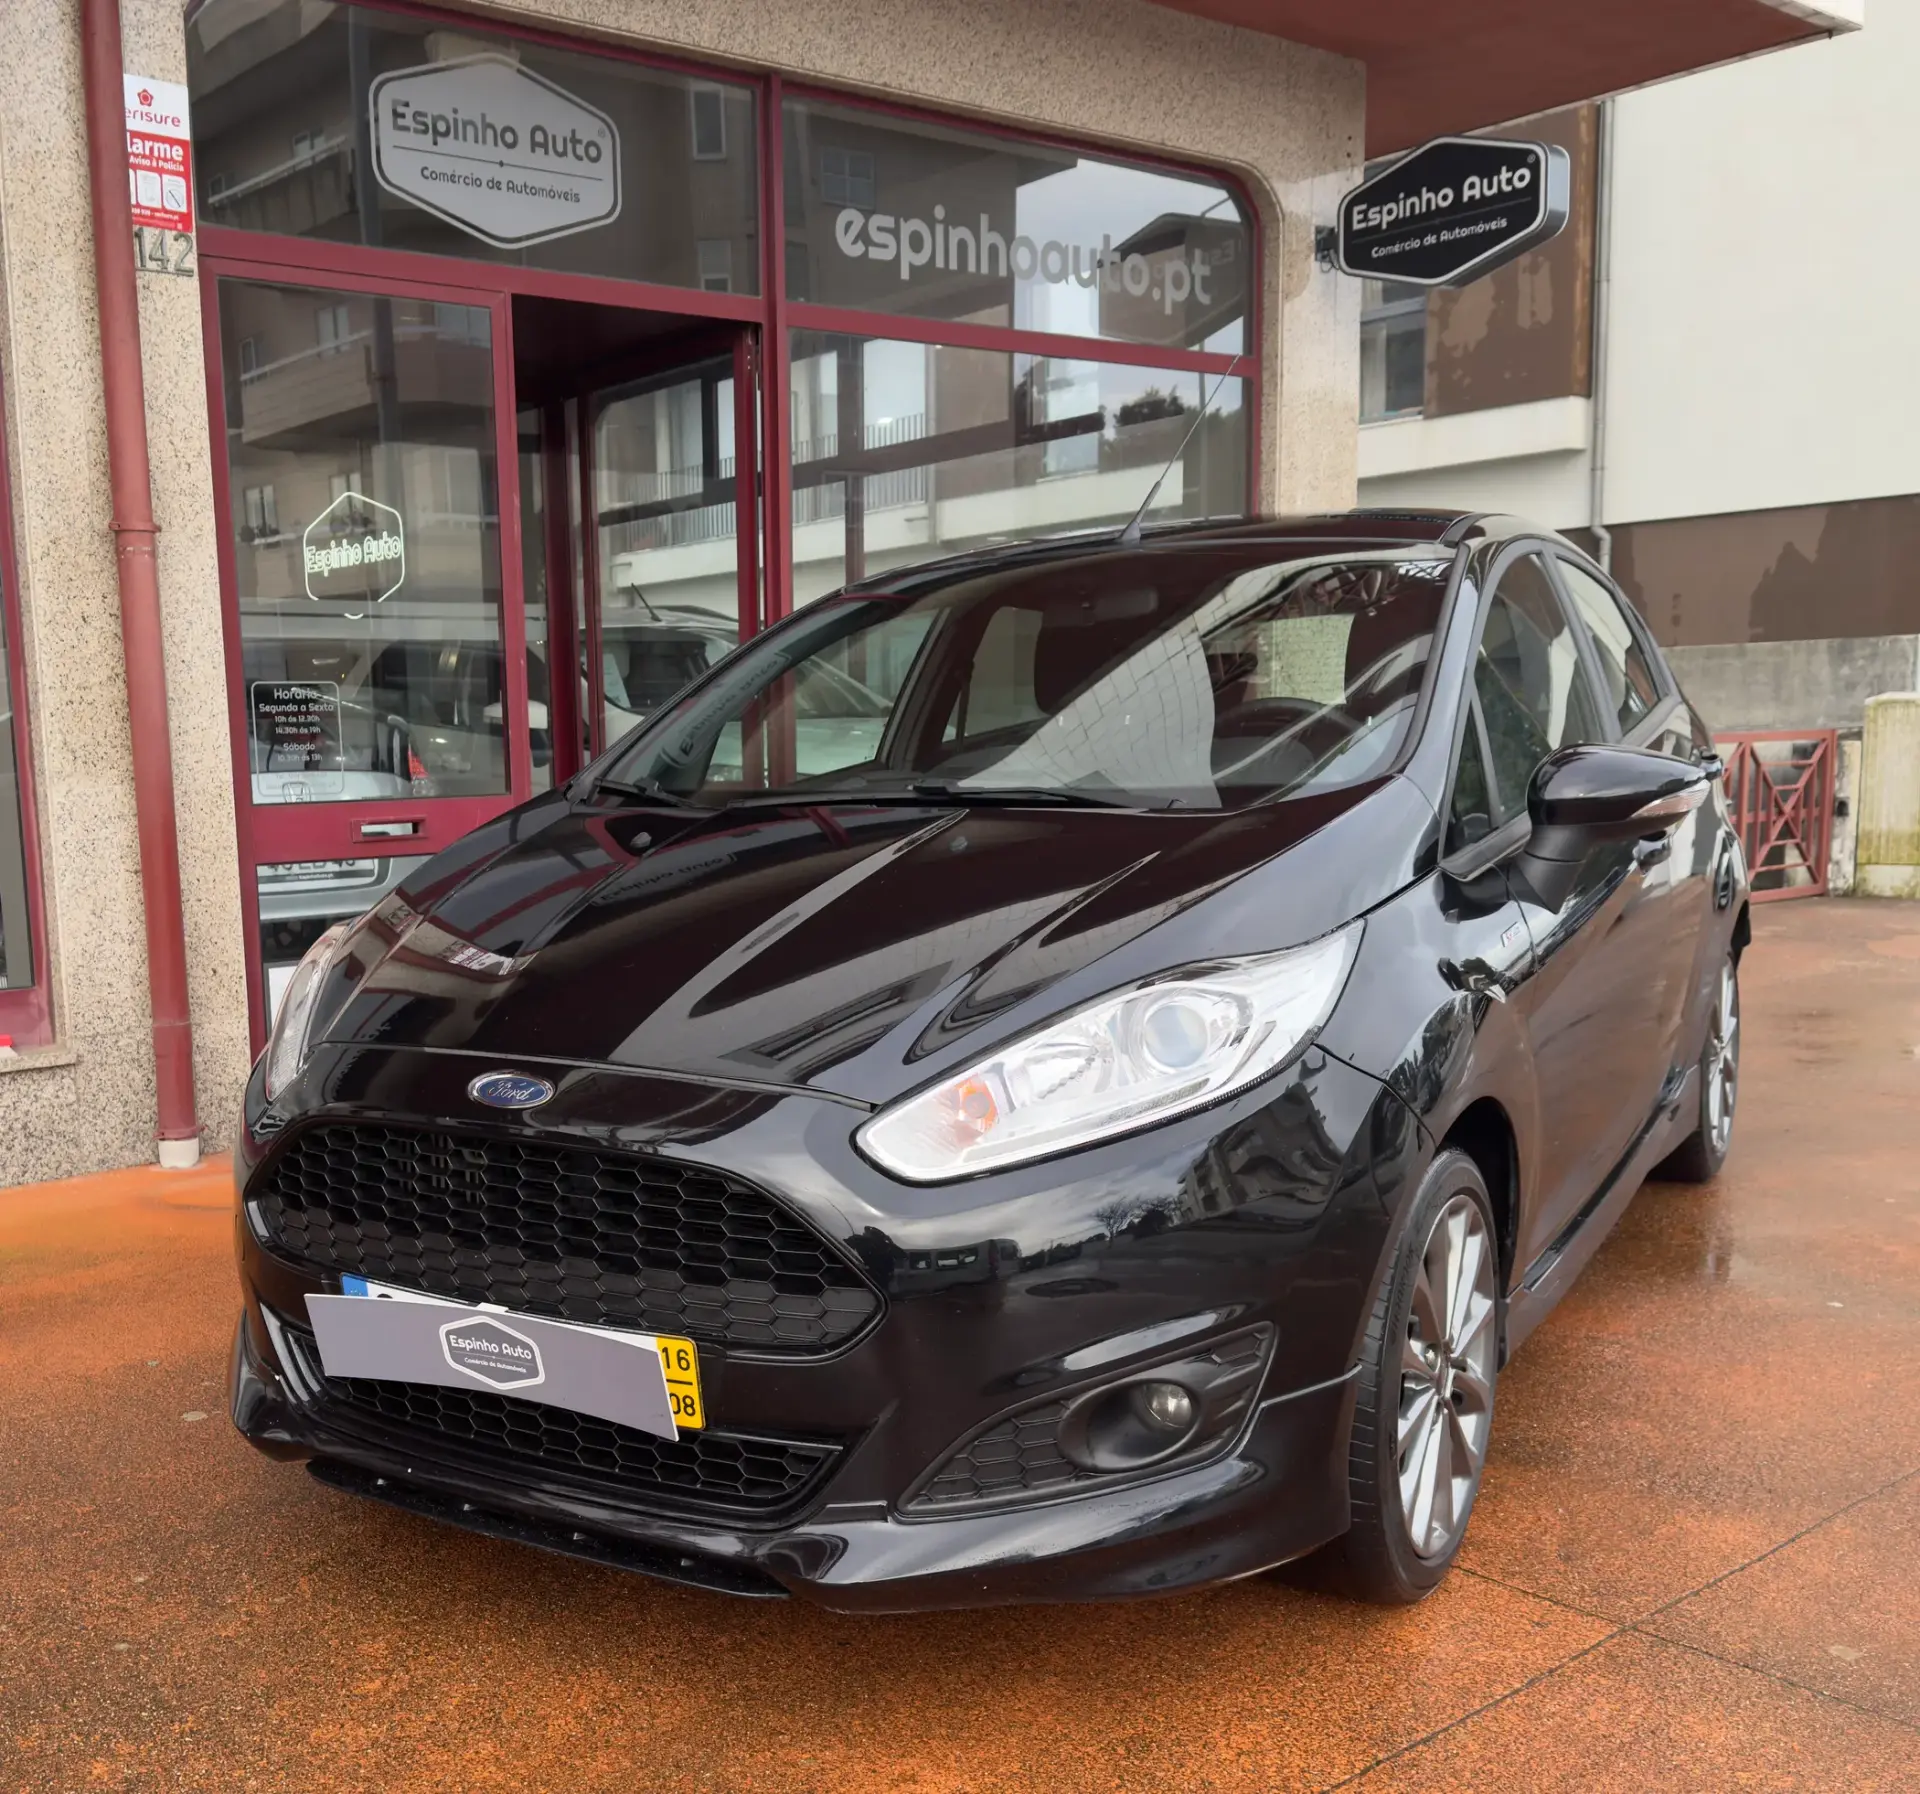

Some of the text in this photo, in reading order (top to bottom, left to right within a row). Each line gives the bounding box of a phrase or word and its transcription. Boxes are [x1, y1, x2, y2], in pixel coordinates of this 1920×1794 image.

[125, 107, 181, 128] erisure
[391, 99, 603, 164] Espinho Auto
[127, 131, 184, 160] larme
[420, 166, 581, 204] Comércio de Automóveis
[1352, 165, 1532, 231] Espinho Auto
[134, 226, 194, 277] 142
[1371, 217, 1508, 258] Comércio de Automóveis
[834, 203, 1212, 316] espinhoauto.pt
[306, 530, 402, 577] Espinho Auto
[259, 703, 298, 714] Segunda
[308, 703, 335, 712] Sexta
[283, 742, 316, 751] Sábado
[488, 1081, 534, 1100] Ford
[449, 1334, 532, 1360] Espinho Auto
[661, 1346, 691, 1372] 16
[668, 1392, 697, 1417] 08
